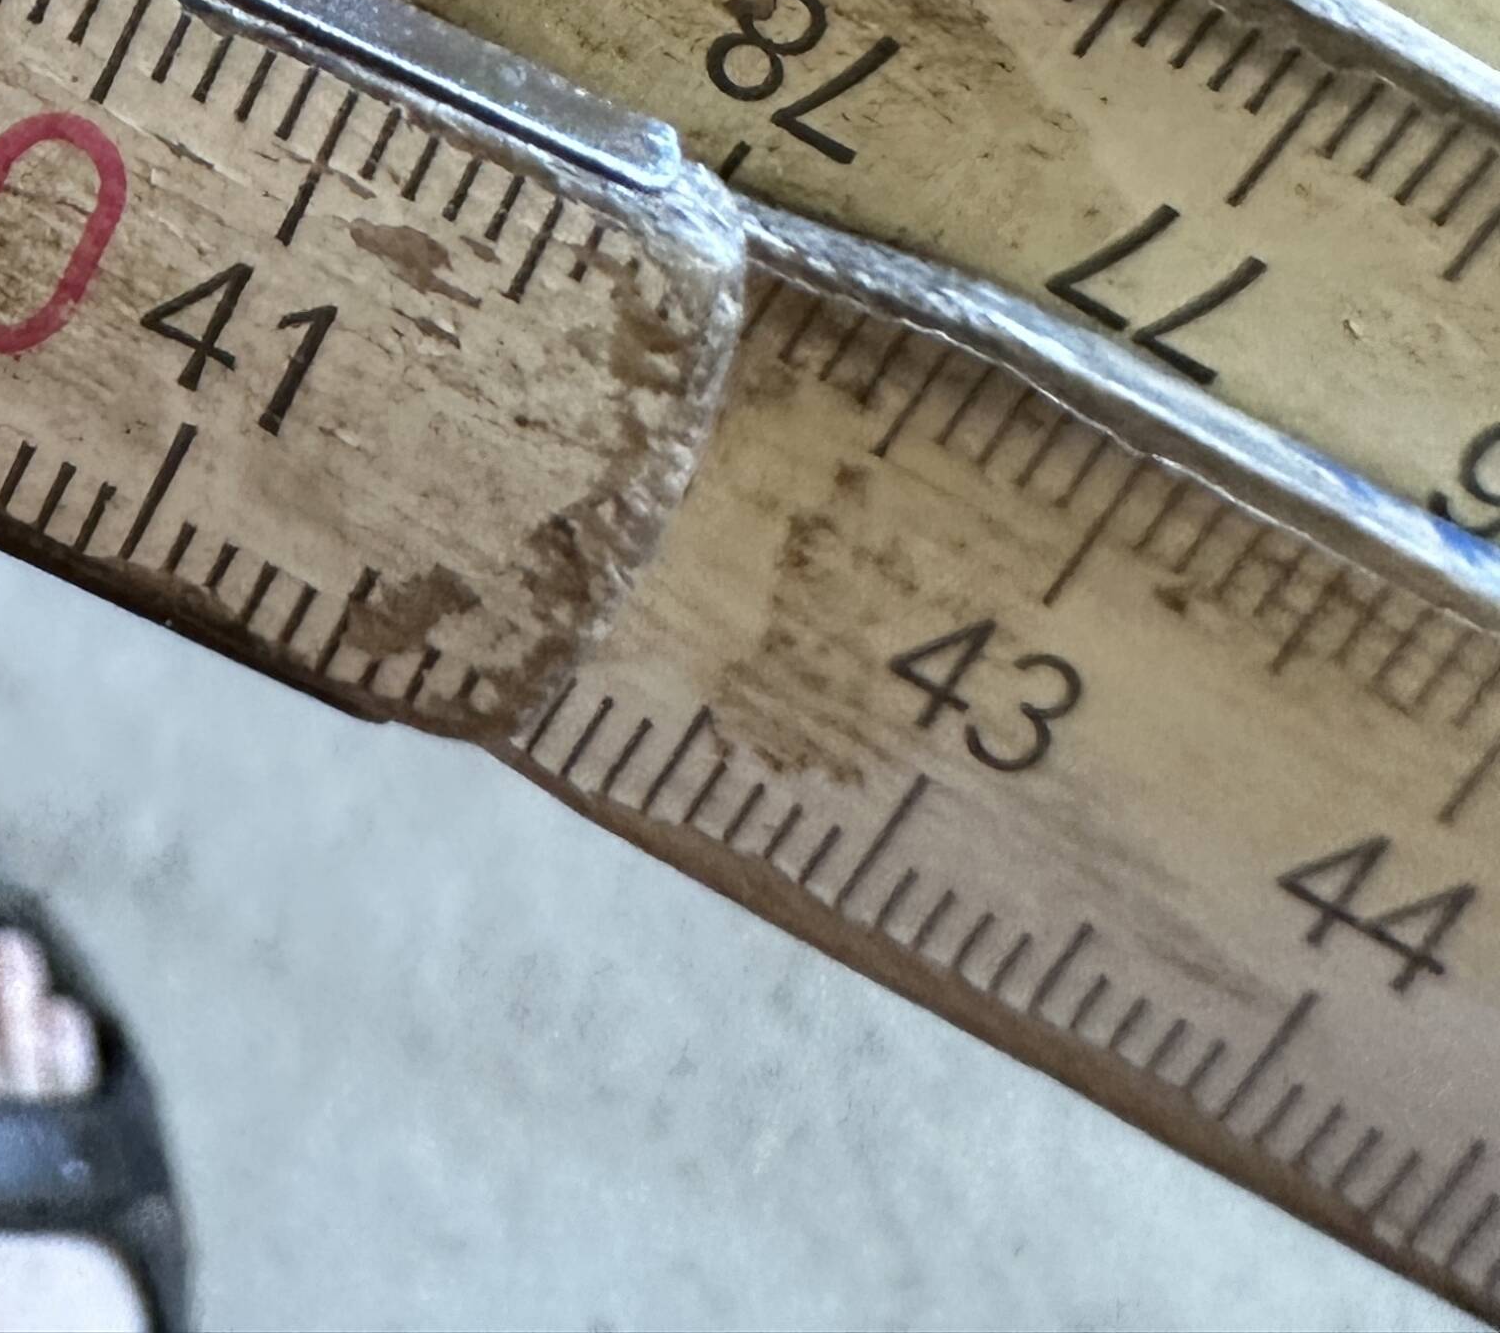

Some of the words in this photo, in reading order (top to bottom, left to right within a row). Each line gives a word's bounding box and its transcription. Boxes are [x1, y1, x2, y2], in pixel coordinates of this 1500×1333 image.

[1045, 202, 1268, 387] 77
[140, 262, 339, 435] 41
[888, 618, 1084, 773] 43
[1276, 835, 1477, 994] 44
